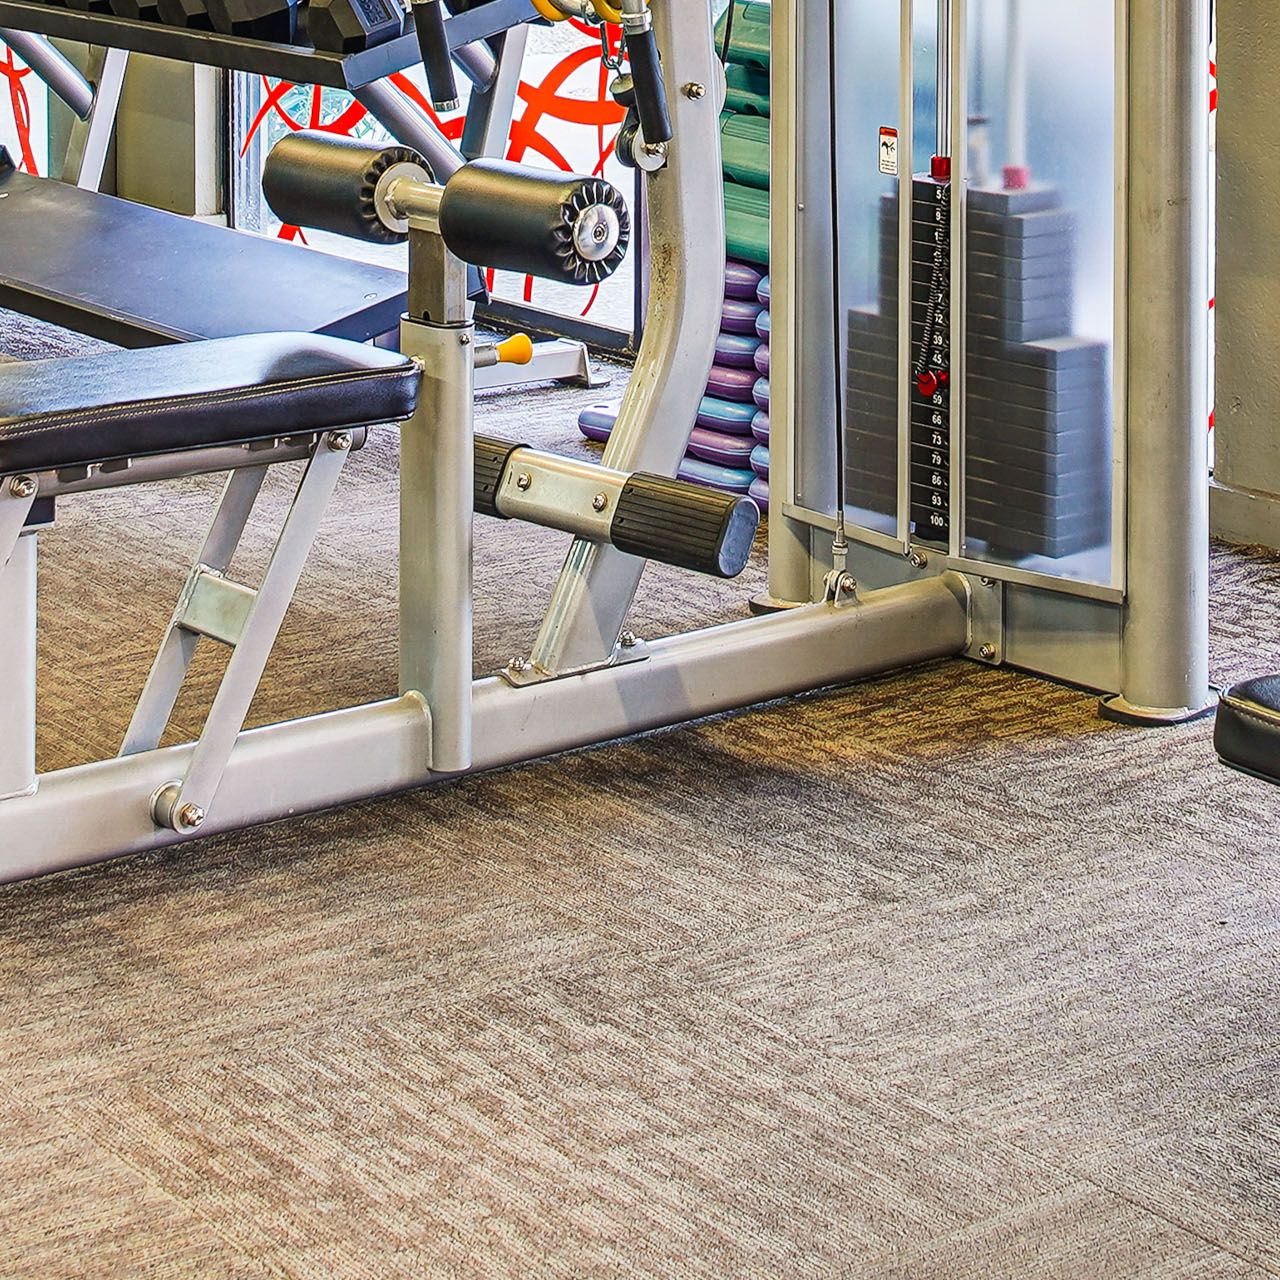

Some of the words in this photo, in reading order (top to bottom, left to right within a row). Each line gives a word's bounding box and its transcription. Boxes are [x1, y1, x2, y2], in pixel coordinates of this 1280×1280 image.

[936, 189, 942, 199] 5
[935, 211, 941, 221] 9
[933, 335, 943, 345] 39
[932, 353, 942, 364] 45
[933, 394, 943, 405] 59
[932, 414, 942, 424] 66
[931, 434, 942, 445] 73
[931, 454, 942, 465] 79
[931, 474, 942, 486] 86
[931, 495, 942, 506] 93
[930, 515, 944, 527] 100
